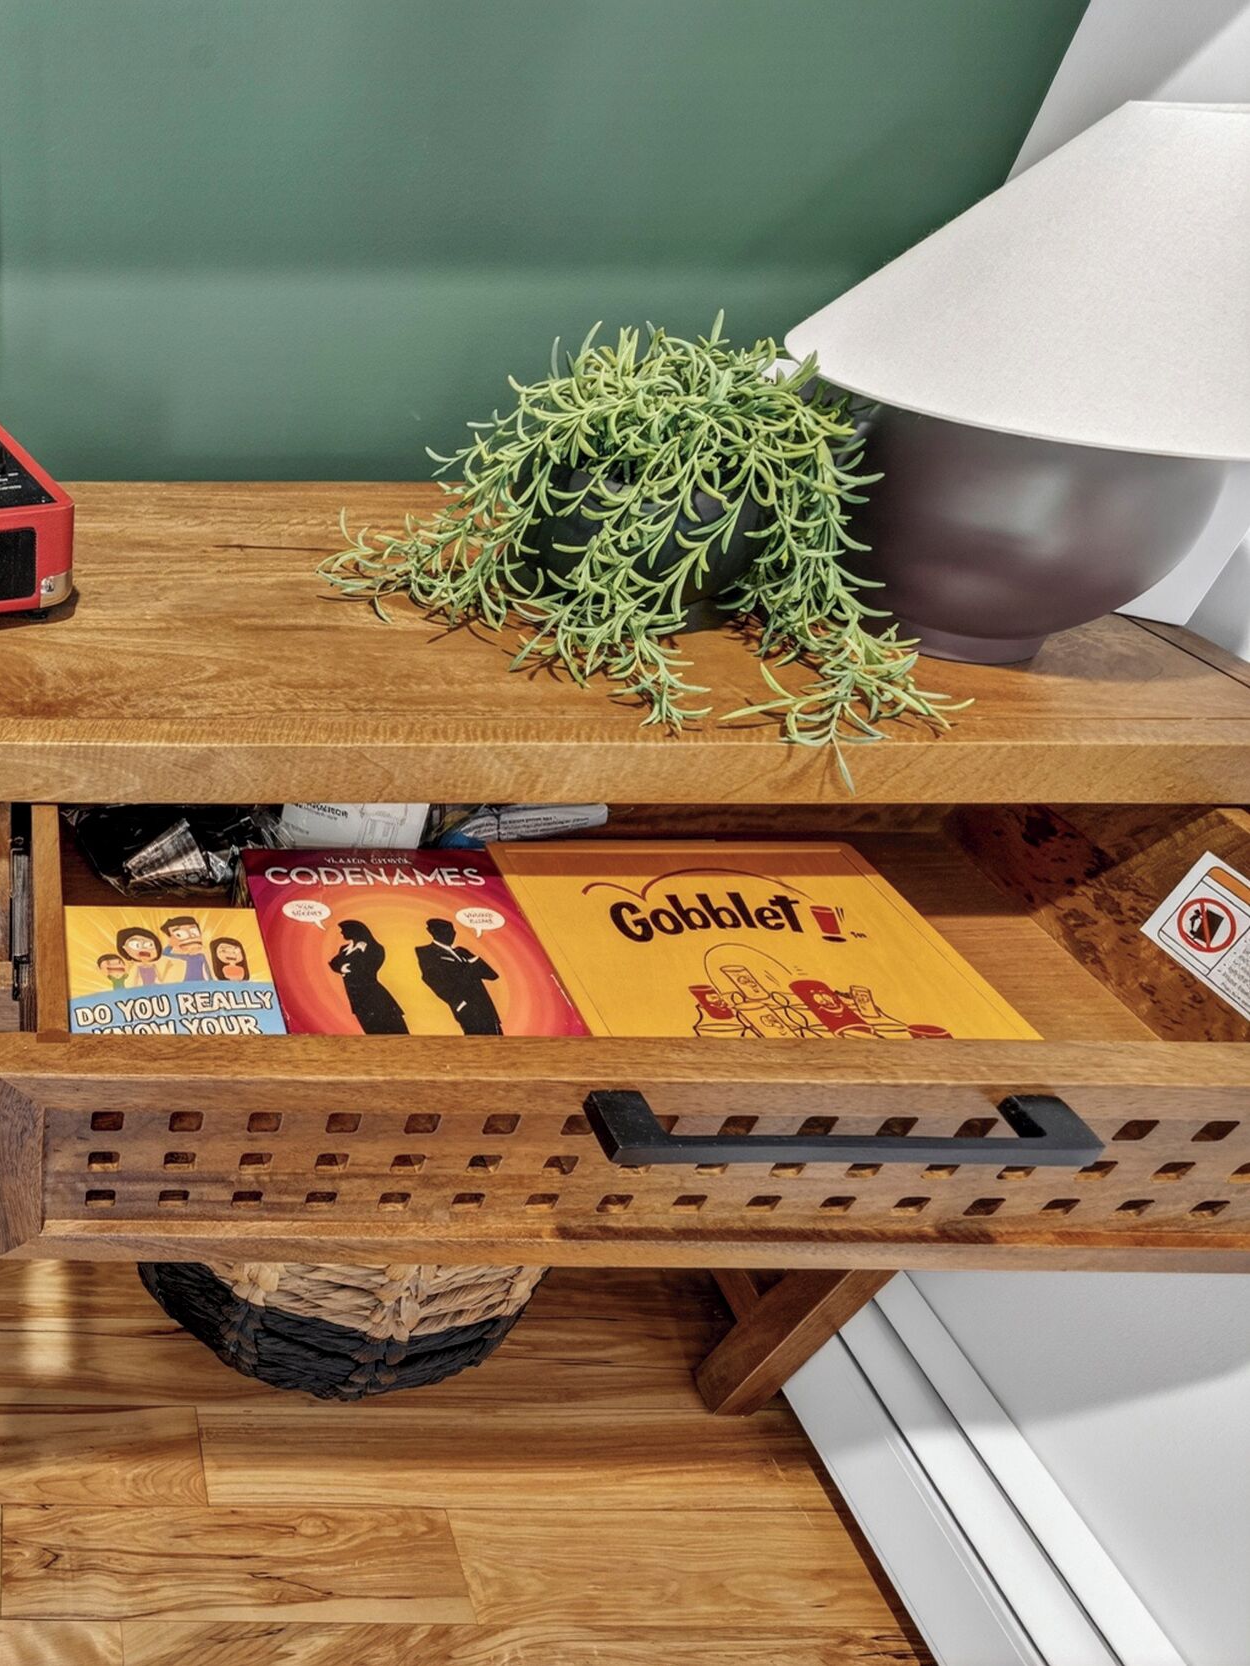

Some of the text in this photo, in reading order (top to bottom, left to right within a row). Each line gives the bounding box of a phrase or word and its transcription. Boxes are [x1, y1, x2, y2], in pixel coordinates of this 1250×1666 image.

[264, 866, 486, 887] CODENAMES
[74, 989, 275, 1027] DO YOU REALLY
[92, 1014, 263, 1035] OW YOUR
